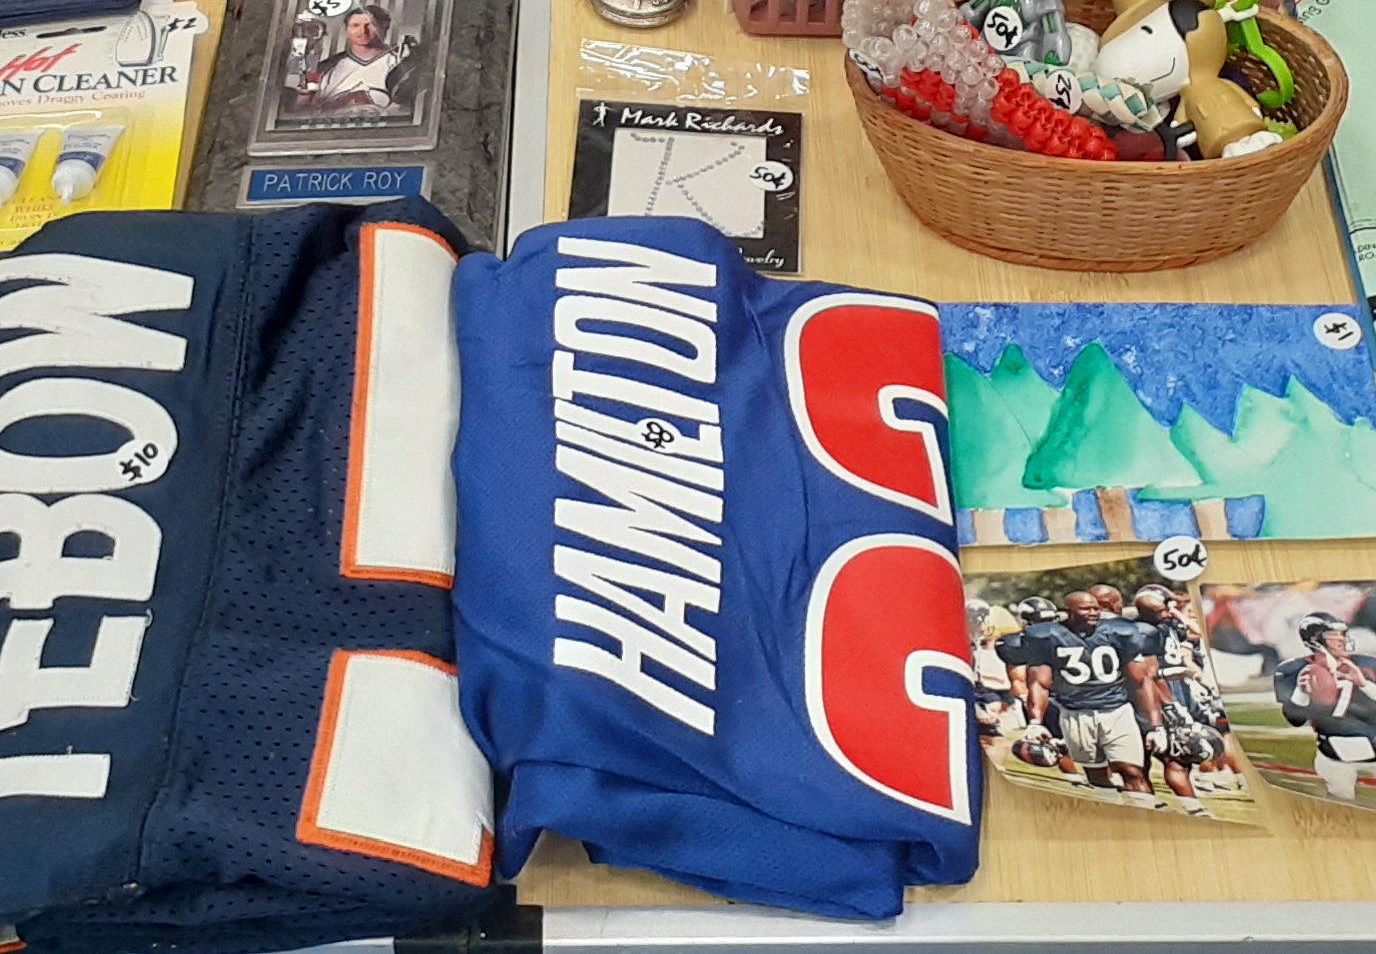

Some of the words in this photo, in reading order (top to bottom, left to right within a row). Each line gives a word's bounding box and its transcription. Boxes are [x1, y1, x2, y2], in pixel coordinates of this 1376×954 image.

[33, 65, 178, 93] CLEANER
[37, 93, 86, 106] Draggy
[91, 89, 146, 102] Coating
[619, 107, 680, 129] Mark
[684, 109, 785, 136] Richards
[263, 172, 353, 192] PATRICK
[363, 170, 407, 190] ROY
[749, 166, 786, 189] 50¢
[1324, 321, 1354, 341] $1
[119, 442, 160, 482] $10
[552, 236, 727, 736] HAMILTON
[1162, 549, 1207, 573] 50¢
[1056, 646, 1120, 685] 30
